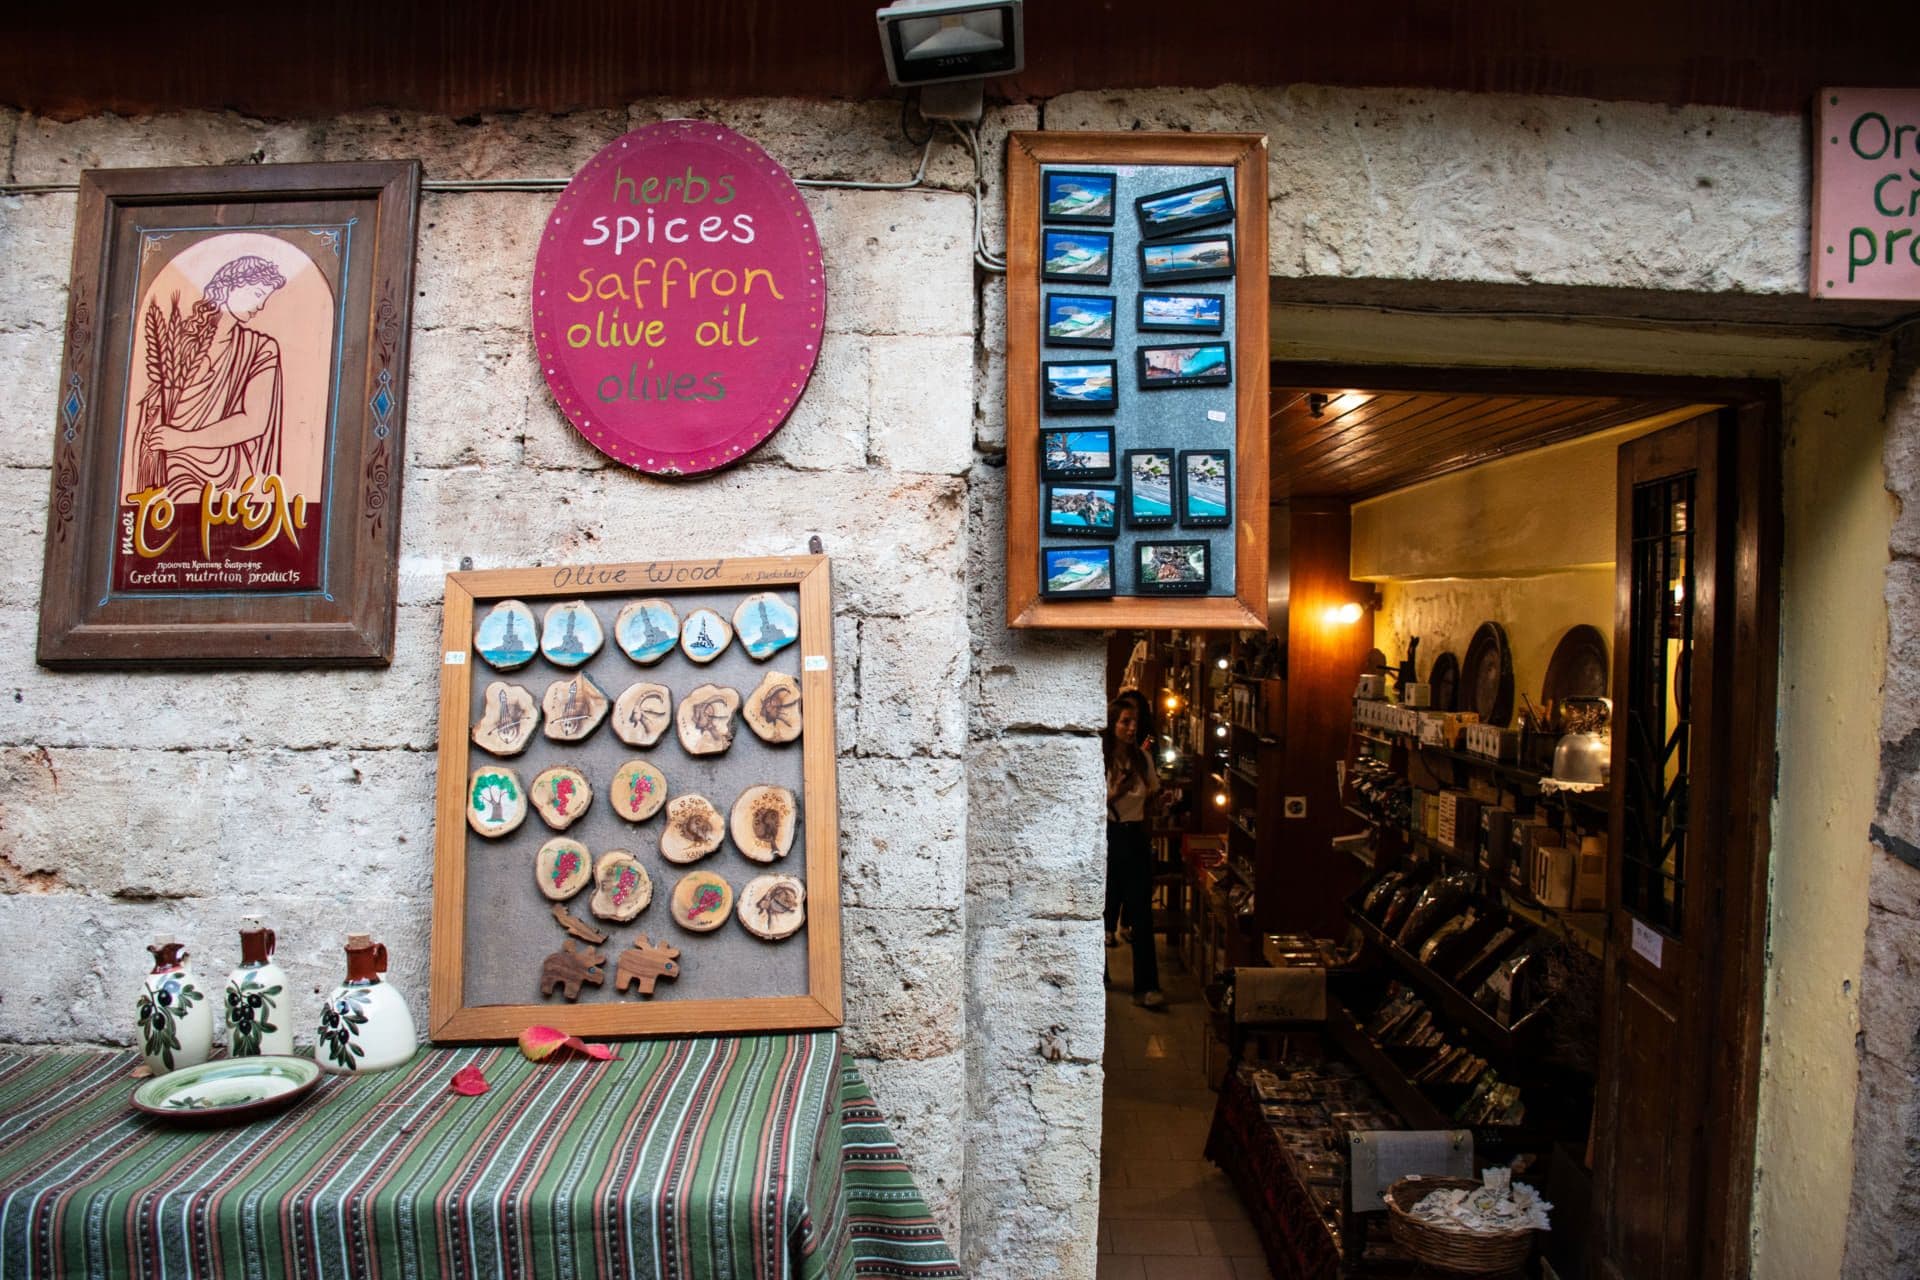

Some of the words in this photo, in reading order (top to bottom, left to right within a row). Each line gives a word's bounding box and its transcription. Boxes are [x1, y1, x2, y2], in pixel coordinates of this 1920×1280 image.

[1850, 112, 1920, 168] Or
[613, 166, 737, 205] herbs
[583, 208, 755, 255] spices
[567, 257, 785, 309] saffron
[567, 307, 667, 348] olive
[695, 303, 760, 347] oil
[598, 358, 727, 403] olives
[129, 569, 178, 584] Cretan
[185, 570, 243, 584] nutrition
[248, 569, 301, 585] products
[553, 565, 627, 588] Olive
[643, 559, 724, 583] Wood
